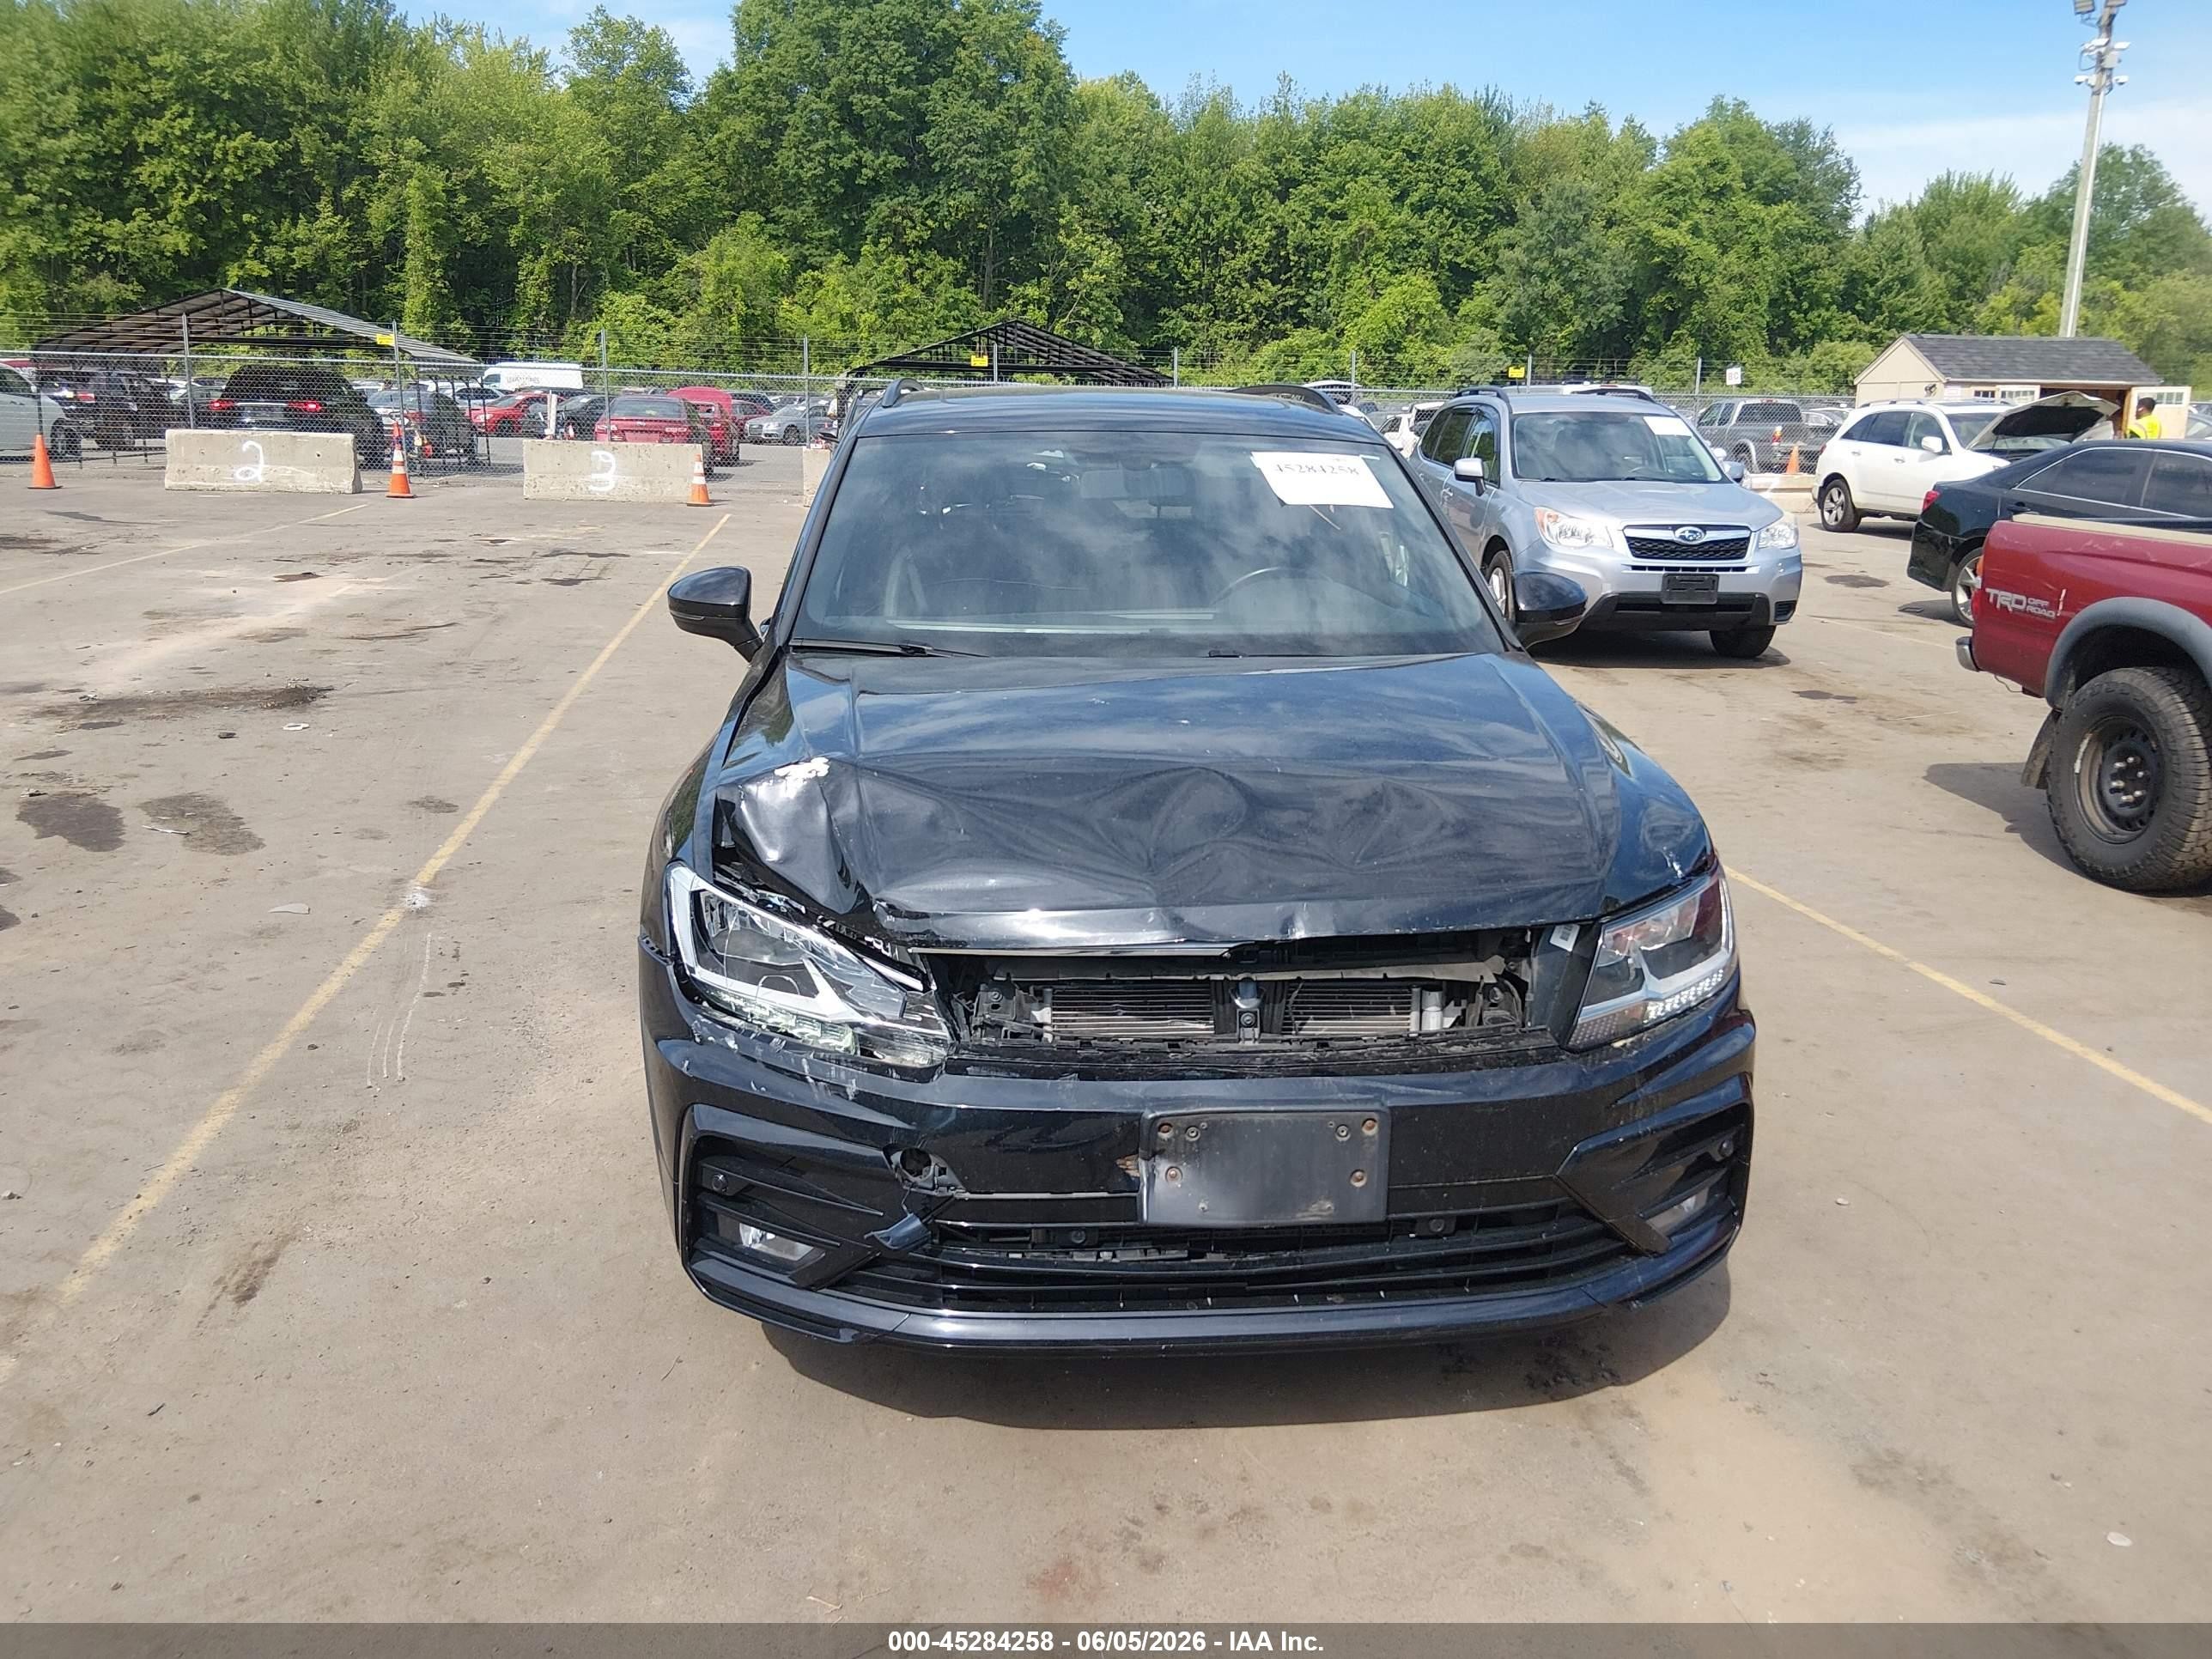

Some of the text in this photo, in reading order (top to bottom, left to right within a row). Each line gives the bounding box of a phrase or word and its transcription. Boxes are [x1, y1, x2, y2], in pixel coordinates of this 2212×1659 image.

[234, 440, 264, 483] 2
[589, 450, 617, 492] 3
[1984, 587, 2027, 612] TRD
[2026, 605, 2056, 619] ROAD
[2027, 597, 2050, 606] OFF
